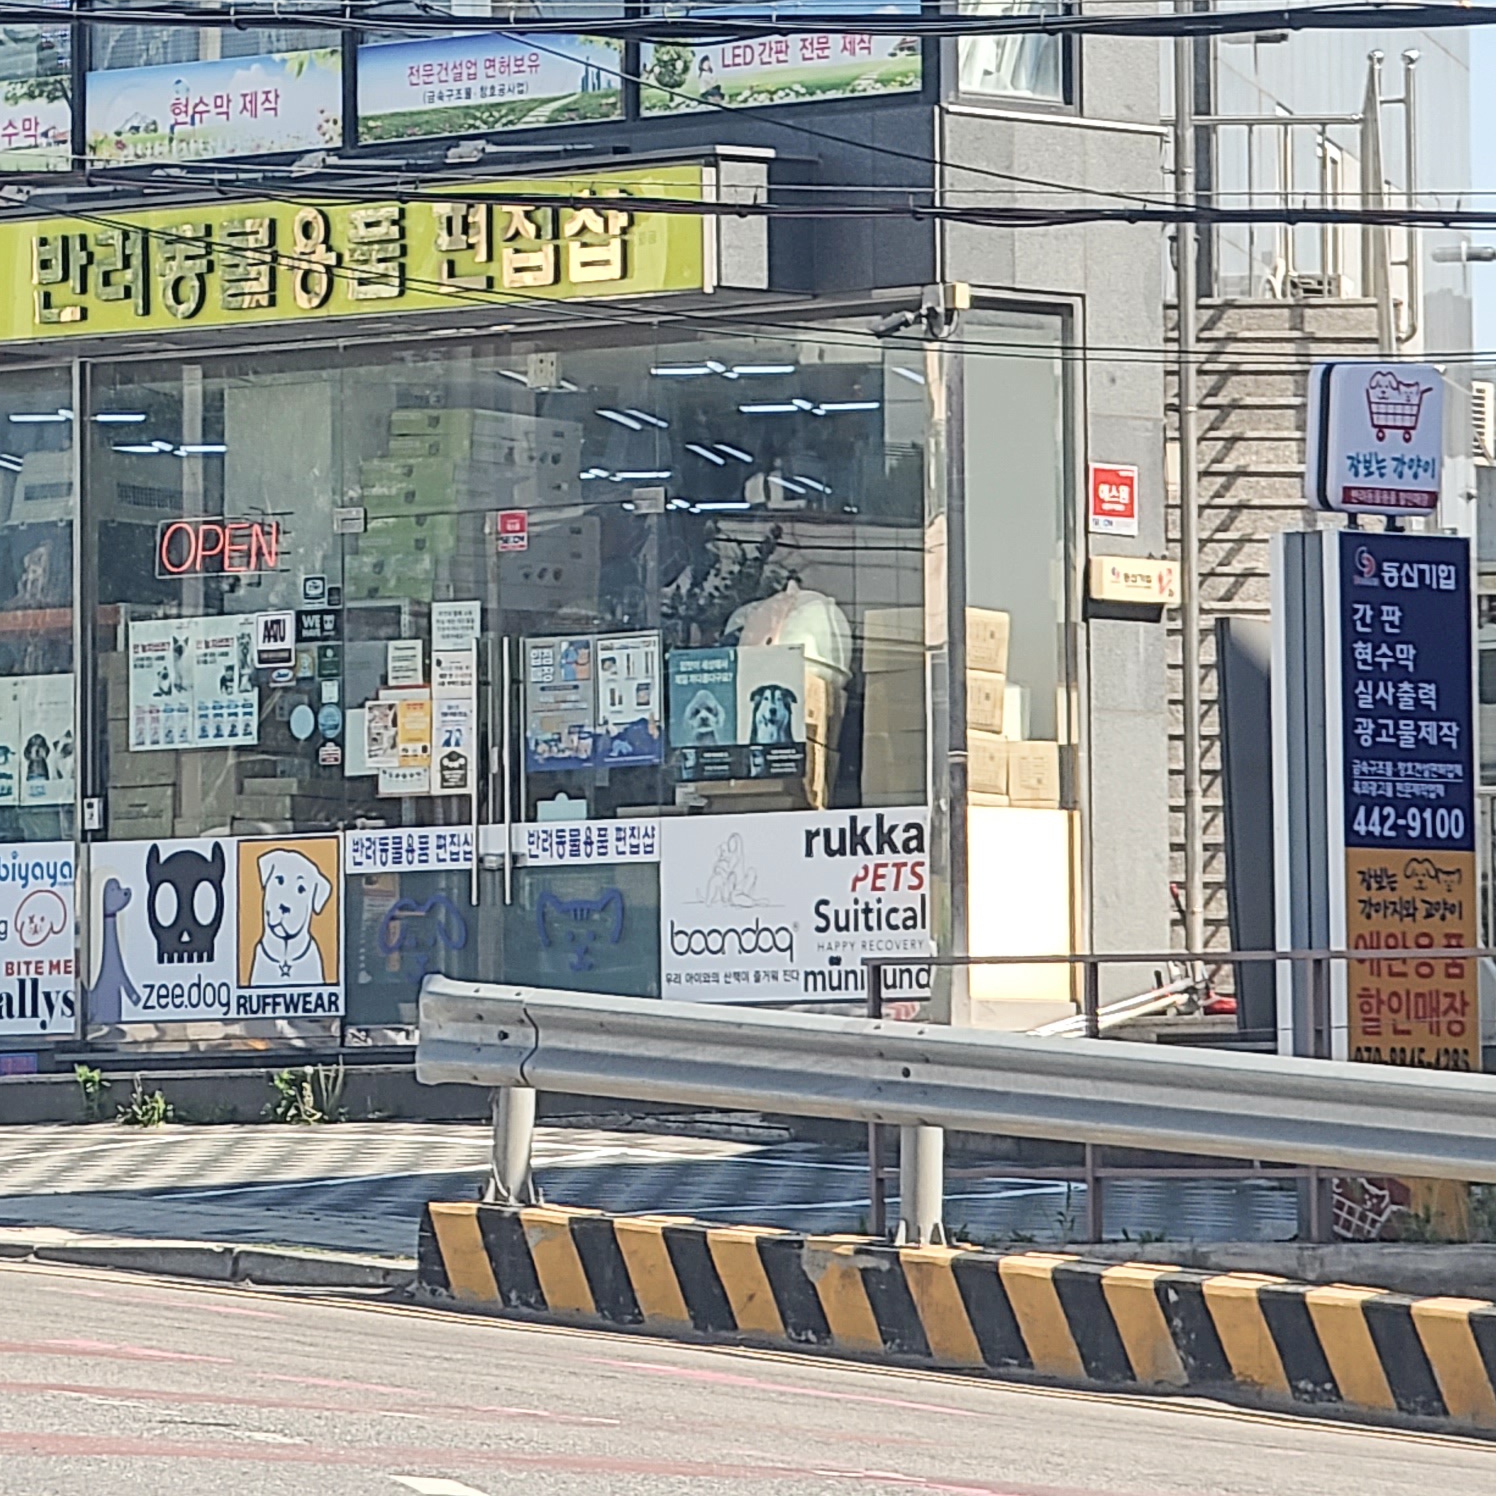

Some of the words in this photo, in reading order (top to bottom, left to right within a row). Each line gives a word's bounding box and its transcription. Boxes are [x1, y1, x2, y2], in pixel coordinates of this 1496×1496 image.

[799, 35, 831, 61] 전문
[407, 58, 478, 87] 전문건설업
[484, 52, 541, 79] 면허보유
[170, 93, 232, 127] 현수막
[239, 88, 280, 119] 제작
[32, 205, 406, 324] 반려동물용품
[434, 188, 635, 288] 편집샵
[161, 521, 278, 574] OPEN
[1380, 562, 1457, 591] 동신기업
[1352, 641, 1417, 673] 현수막
[1354, 681, 1438, 712] 실사출력
[1353, 717, 1460, 749] 광고물제작
[804, 813, 926, 858] rukka
[1352, 805, 1464, 840] 442-9100
[352, 833, 430, 867] 반려동물용품
[526, 825, 609, 860] 반려동물용품
[615, 824, 657, 856] 편집샵
[850, 860, 926, 893] PETS
[1357, 867, 1399, 892] 장보는
[813, 893, 927, 934] Suitical
[1420, 898, 1463, 922] 고양이
[816, 940, 856, 952] HAPPY
[860, 939, 925, 952] RECOVERY
[4, 961, 45, 977] BITE
[48, 958, 74, 975] ME
[141, 973, 232, 1017] zee.dog
[235, 992, 340, 1016] RUFFWEAR
[1356, 987, 1470, 1038] 할인매장
